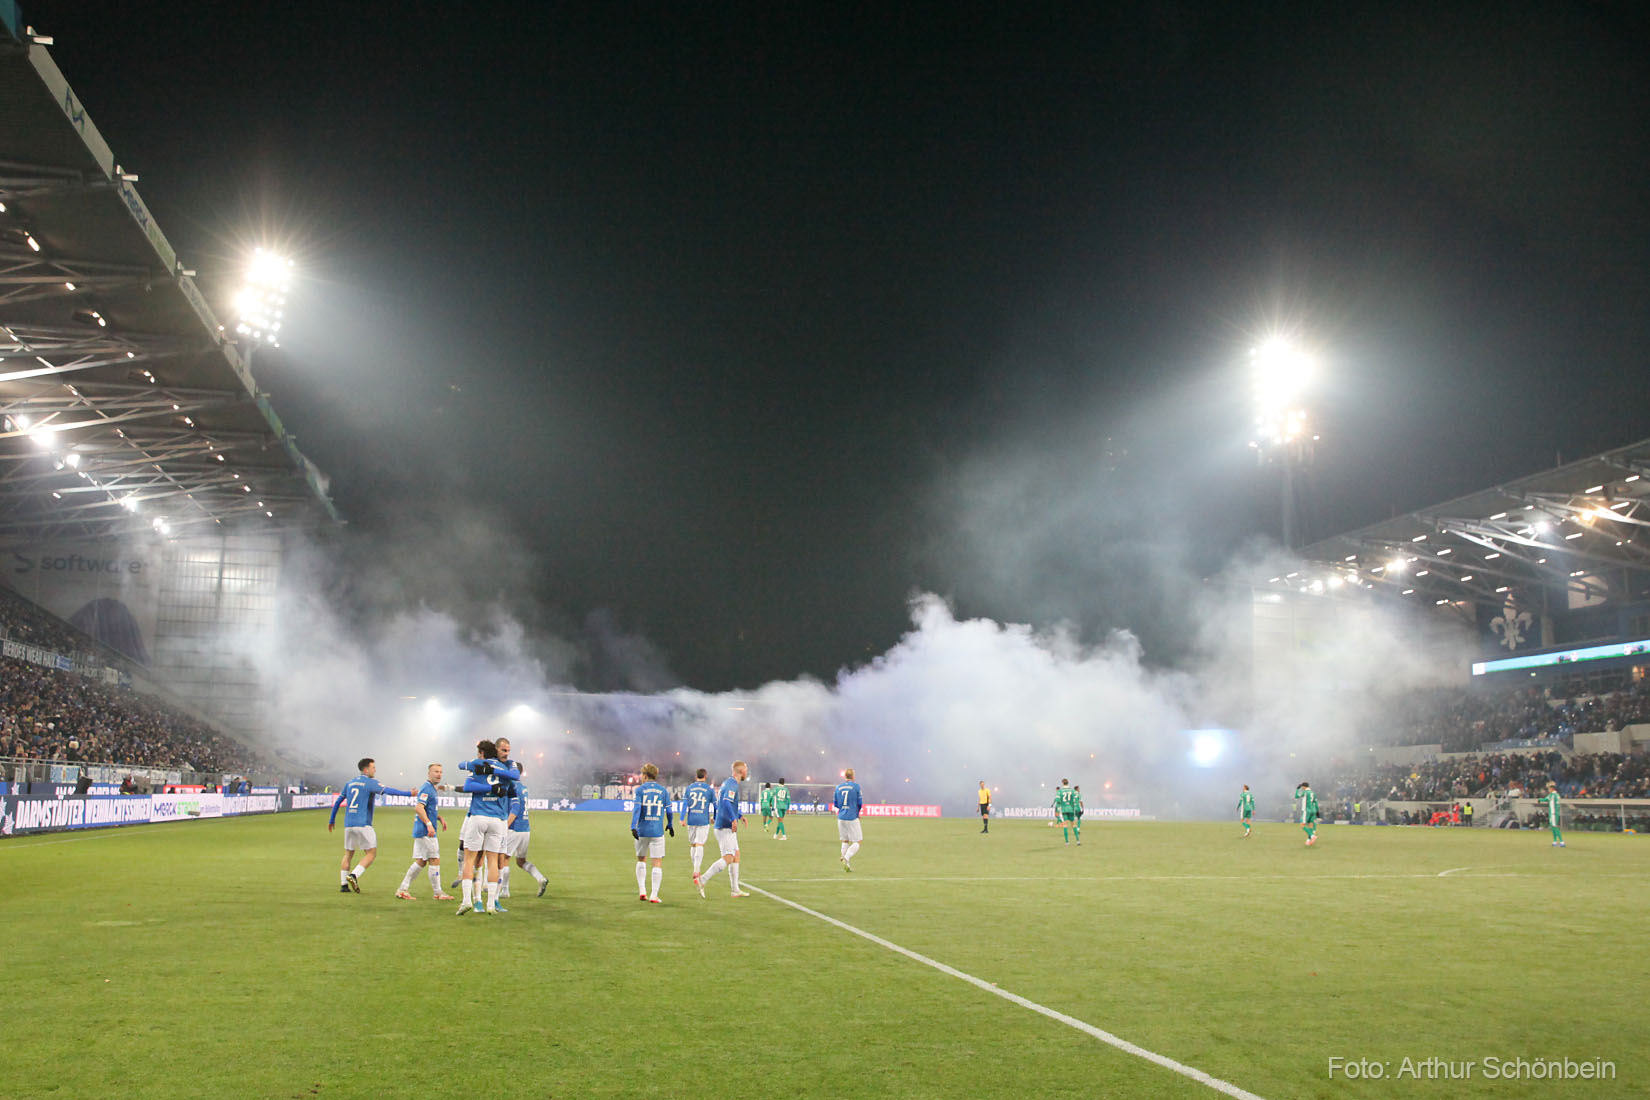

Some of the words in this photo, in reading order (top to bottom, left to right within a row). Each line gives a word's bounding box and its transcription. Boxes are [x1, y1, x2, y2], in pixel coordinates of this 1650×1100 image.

[40, 554, 142, 575] software
[349, 787, 360, 809] 2
[641, 794, 665, 817] 44
[689, 791, 707, 810] 34
[841, 789, 850, 806] 7
[1062, 791, 1072, 802] 27
[15, 795, 85, 829] DARMSTÄDTER
[154, 801, 177, 816] MERCK
